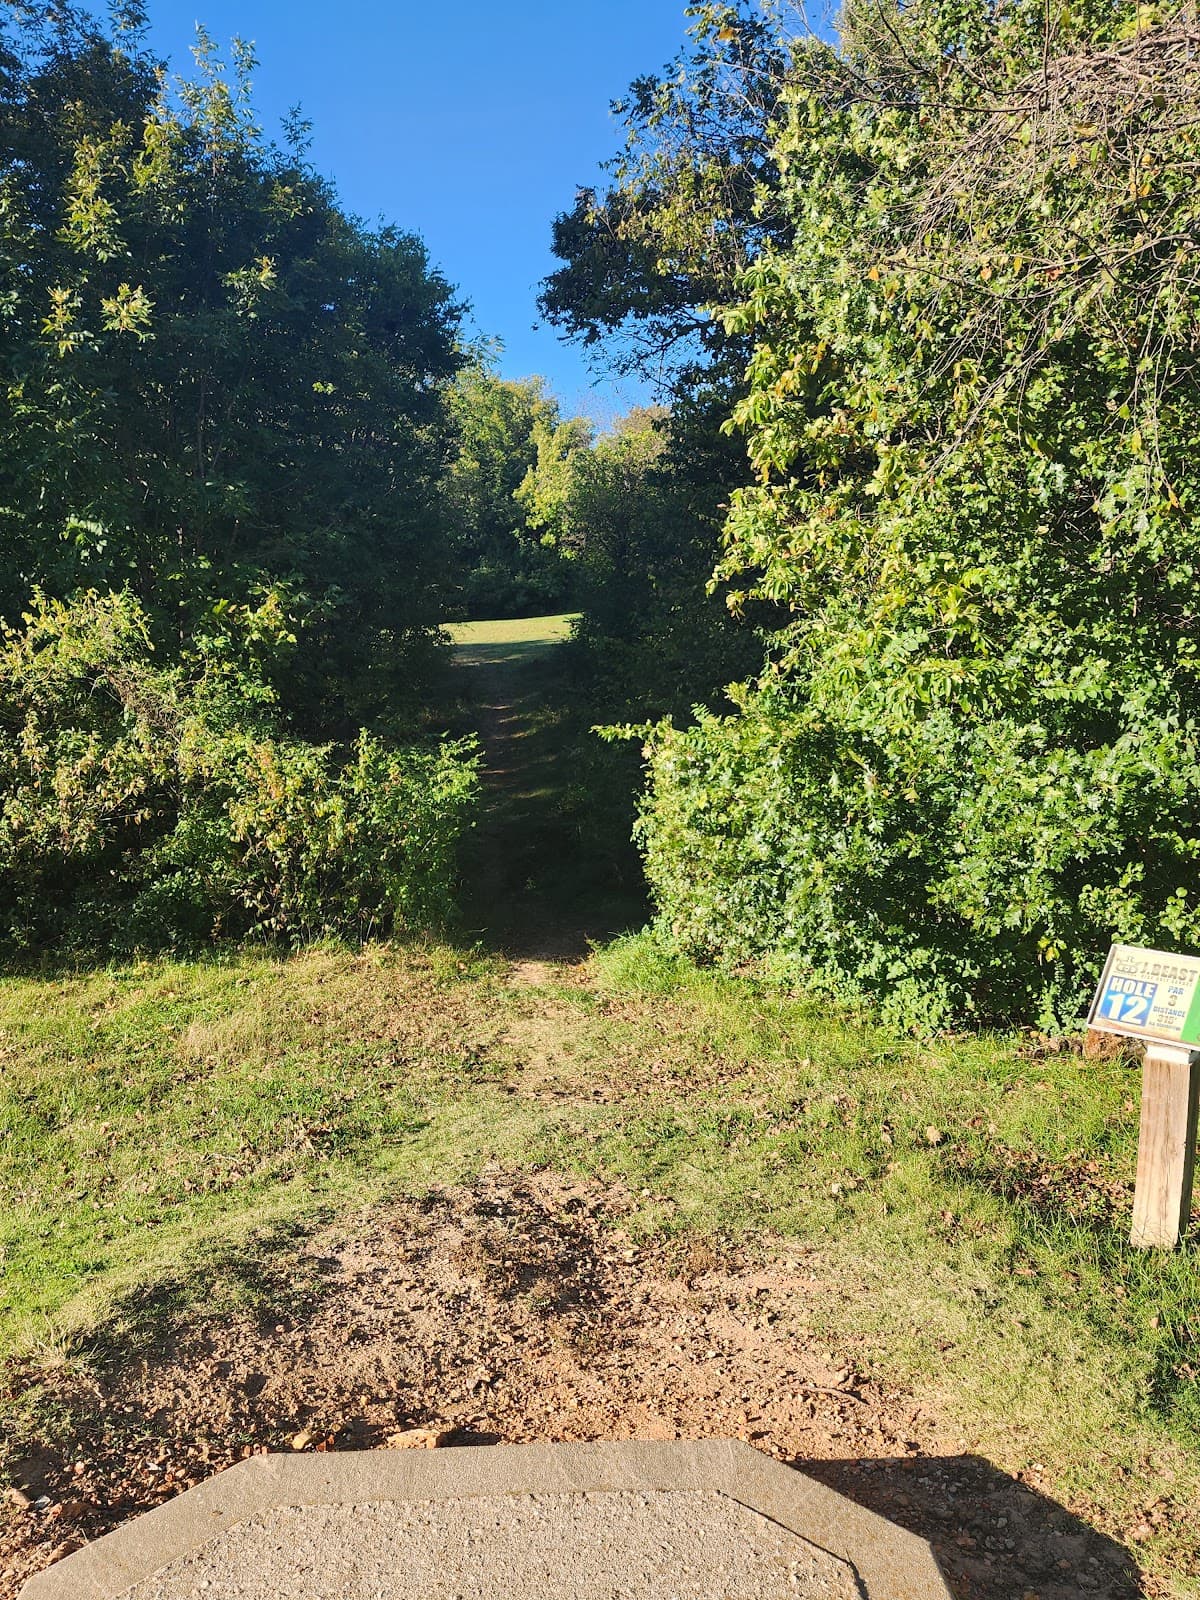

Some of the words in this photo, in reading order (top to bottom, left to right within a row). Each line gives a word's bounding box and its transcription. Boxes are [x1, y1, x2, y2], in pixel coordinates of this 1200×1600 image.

[1110, 977, 1155, 998] HOLE
[1168, 986, 1185, 995] PAR
[1168, 995, 1178, 1007] 3
[1108, 993, 1148, 1025] 12
[1152, 1006, 1186, 1018] DISTANCE
